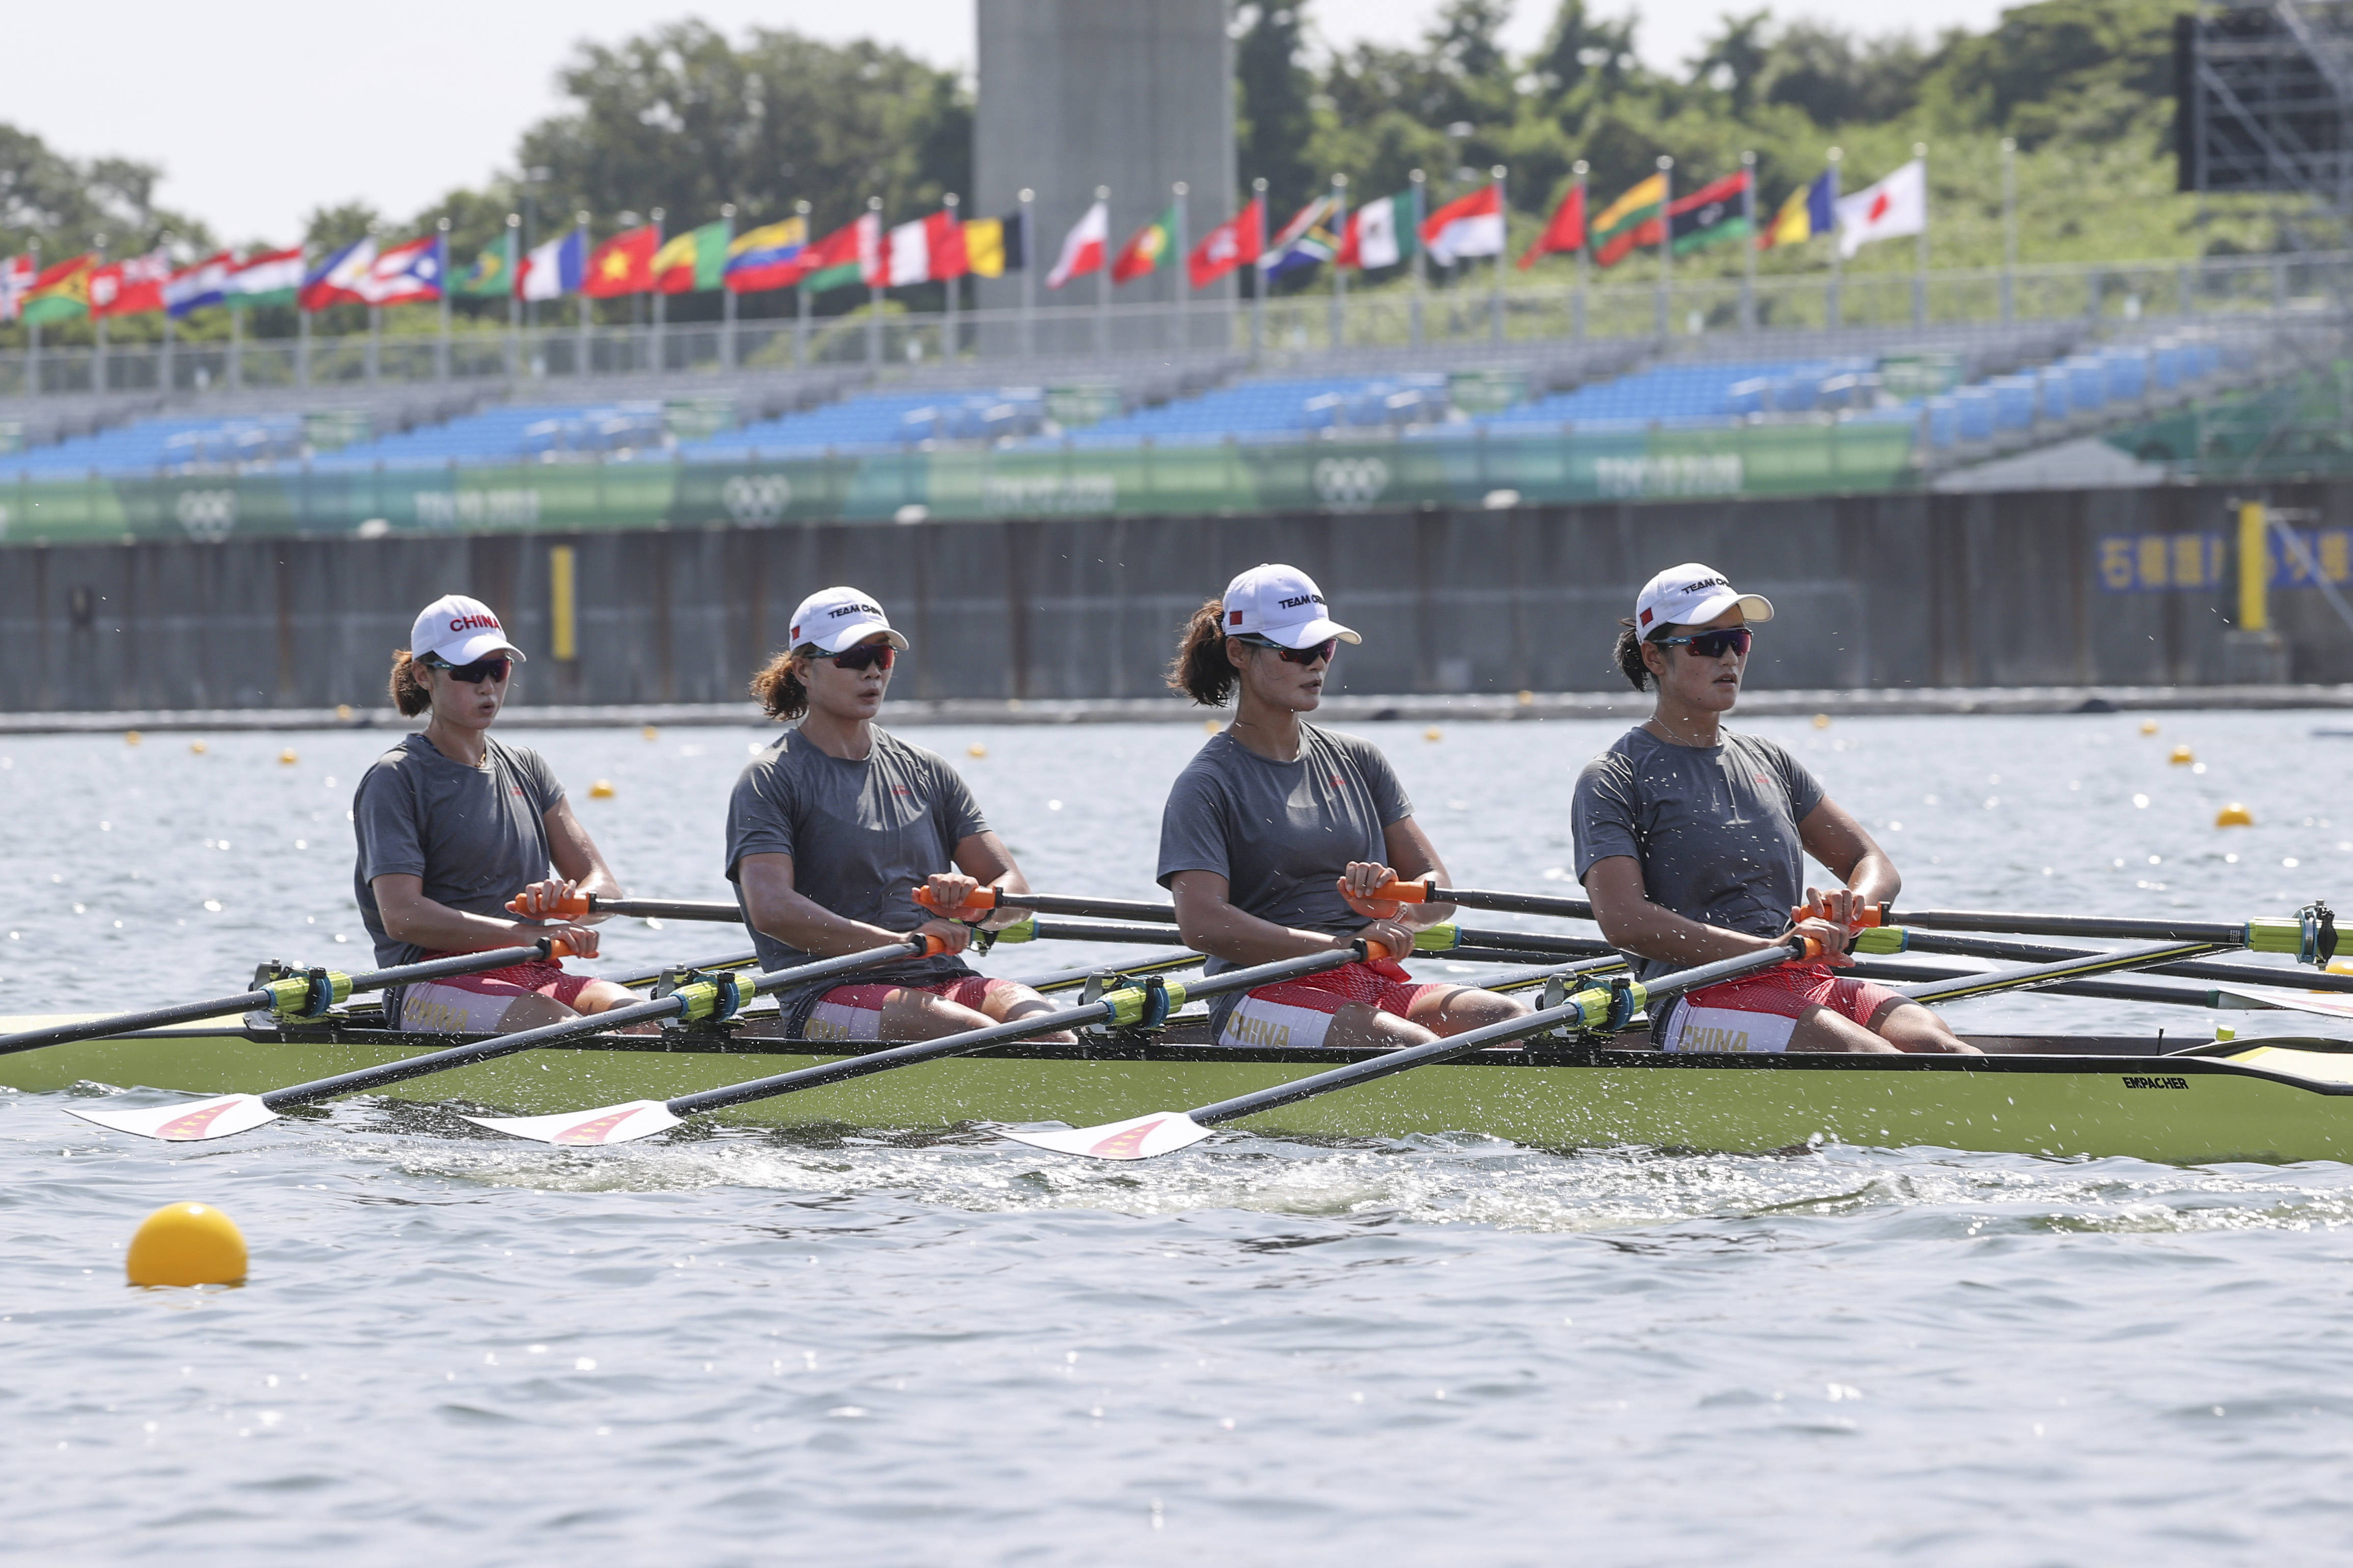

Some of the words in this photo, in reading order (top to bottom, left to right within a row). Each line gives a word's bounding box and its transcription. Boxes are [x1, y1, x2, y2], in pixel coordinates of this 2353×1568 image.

[1682, 579, 1715, 594] TEAM
[1278, 595, 1311, 609] TEAM
[828, 604, 860, 618] TEAM
[450, 615, 501, 631] CHINA
[1226, 1011, 1289, 1047] CHINA
[1680, 1025, 1748, 1051] CHINA
[2122, 1077, 2189, 1089] EMPACHER
